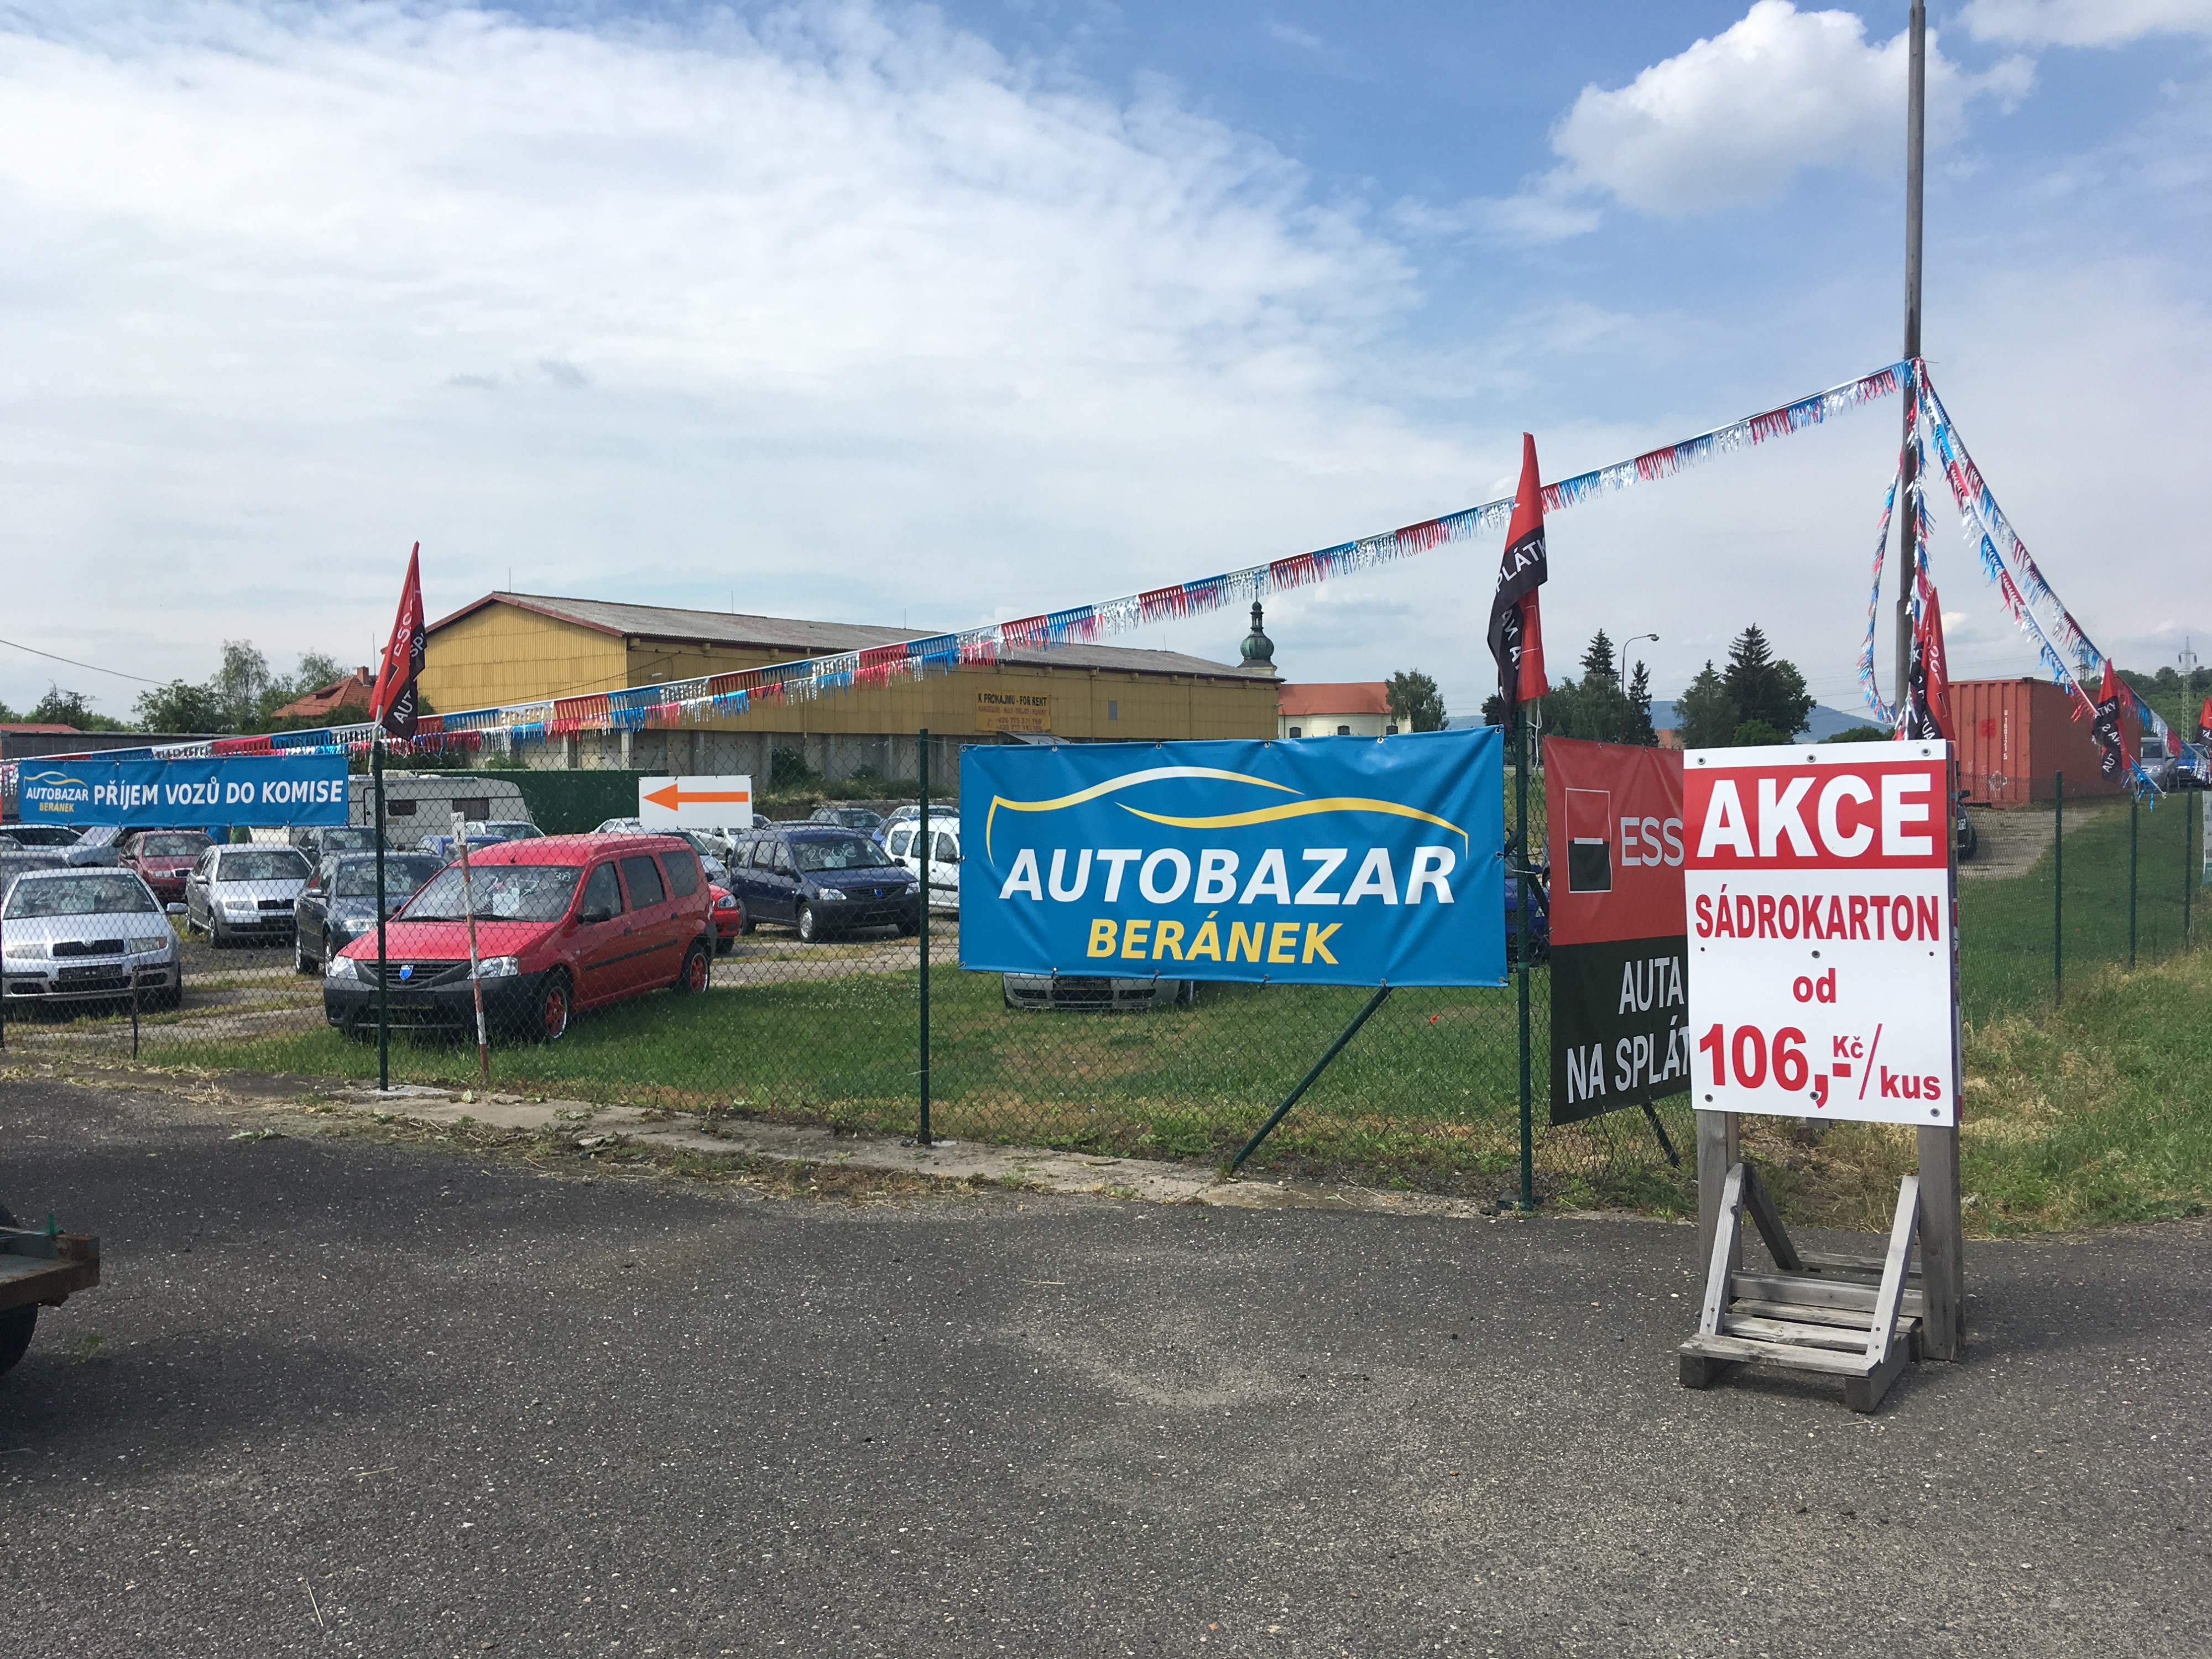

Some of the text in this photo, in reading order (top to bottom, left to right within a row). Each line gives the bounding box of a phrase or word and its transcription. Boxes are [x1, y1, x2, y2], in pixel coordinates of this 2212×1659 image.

[978, 693, 982, 703] K
[1020, 696, 1031, 706] FOR
[1032, 697, 1047, 706] RENT
[25, 786, 89, 801] AUTOBAZAR
[39, 801, 75, 812] BERÁNEK
[94, 776, 343, 810] PŘÍJEM VOZŮ DO KOMISE
[1696, 773, 1933, 858] AKCE
[999, 844, 1456, 906] AUTOBAZAR
[1086, 911, 1343, 964] BERÁNEK
[1695, 884, 1940, 941] SÁDROKARTON
[1619, 956, 1685, 1015] AUTA
[1793, 967, 1837, 1004] od
[1567, 1042, 1606, 1104] NA
